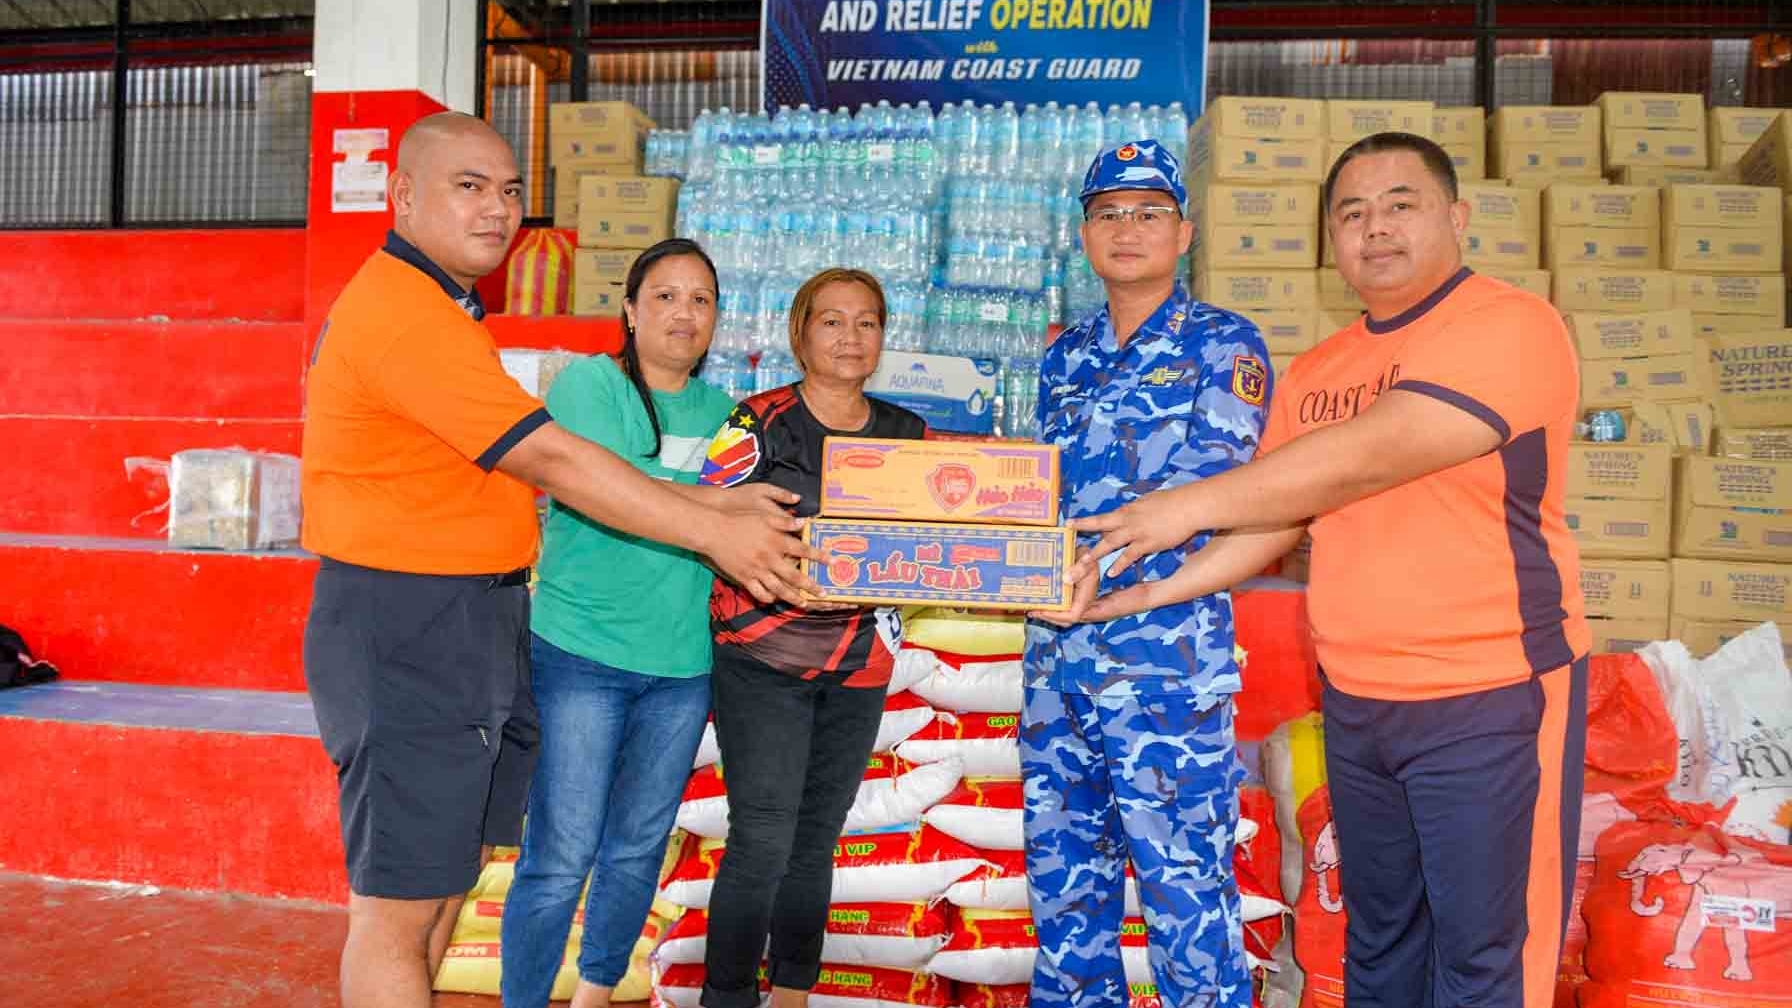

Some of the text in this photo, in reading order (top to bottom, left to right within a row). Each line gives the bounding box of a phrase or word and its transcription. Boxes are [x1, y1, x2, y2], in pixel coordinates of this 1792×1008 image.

[820, 0, 1152, 32] AND RELIEF OPERATION
[964, 40, 998, 53] with
[827, 58, 1142, 81] VIETNAM COAST GUARD
[888, 374, 945, 393] AQUAFINA
[1299, 383, 1367, 424] COAST
[846, 843, 876, 856] VIP
